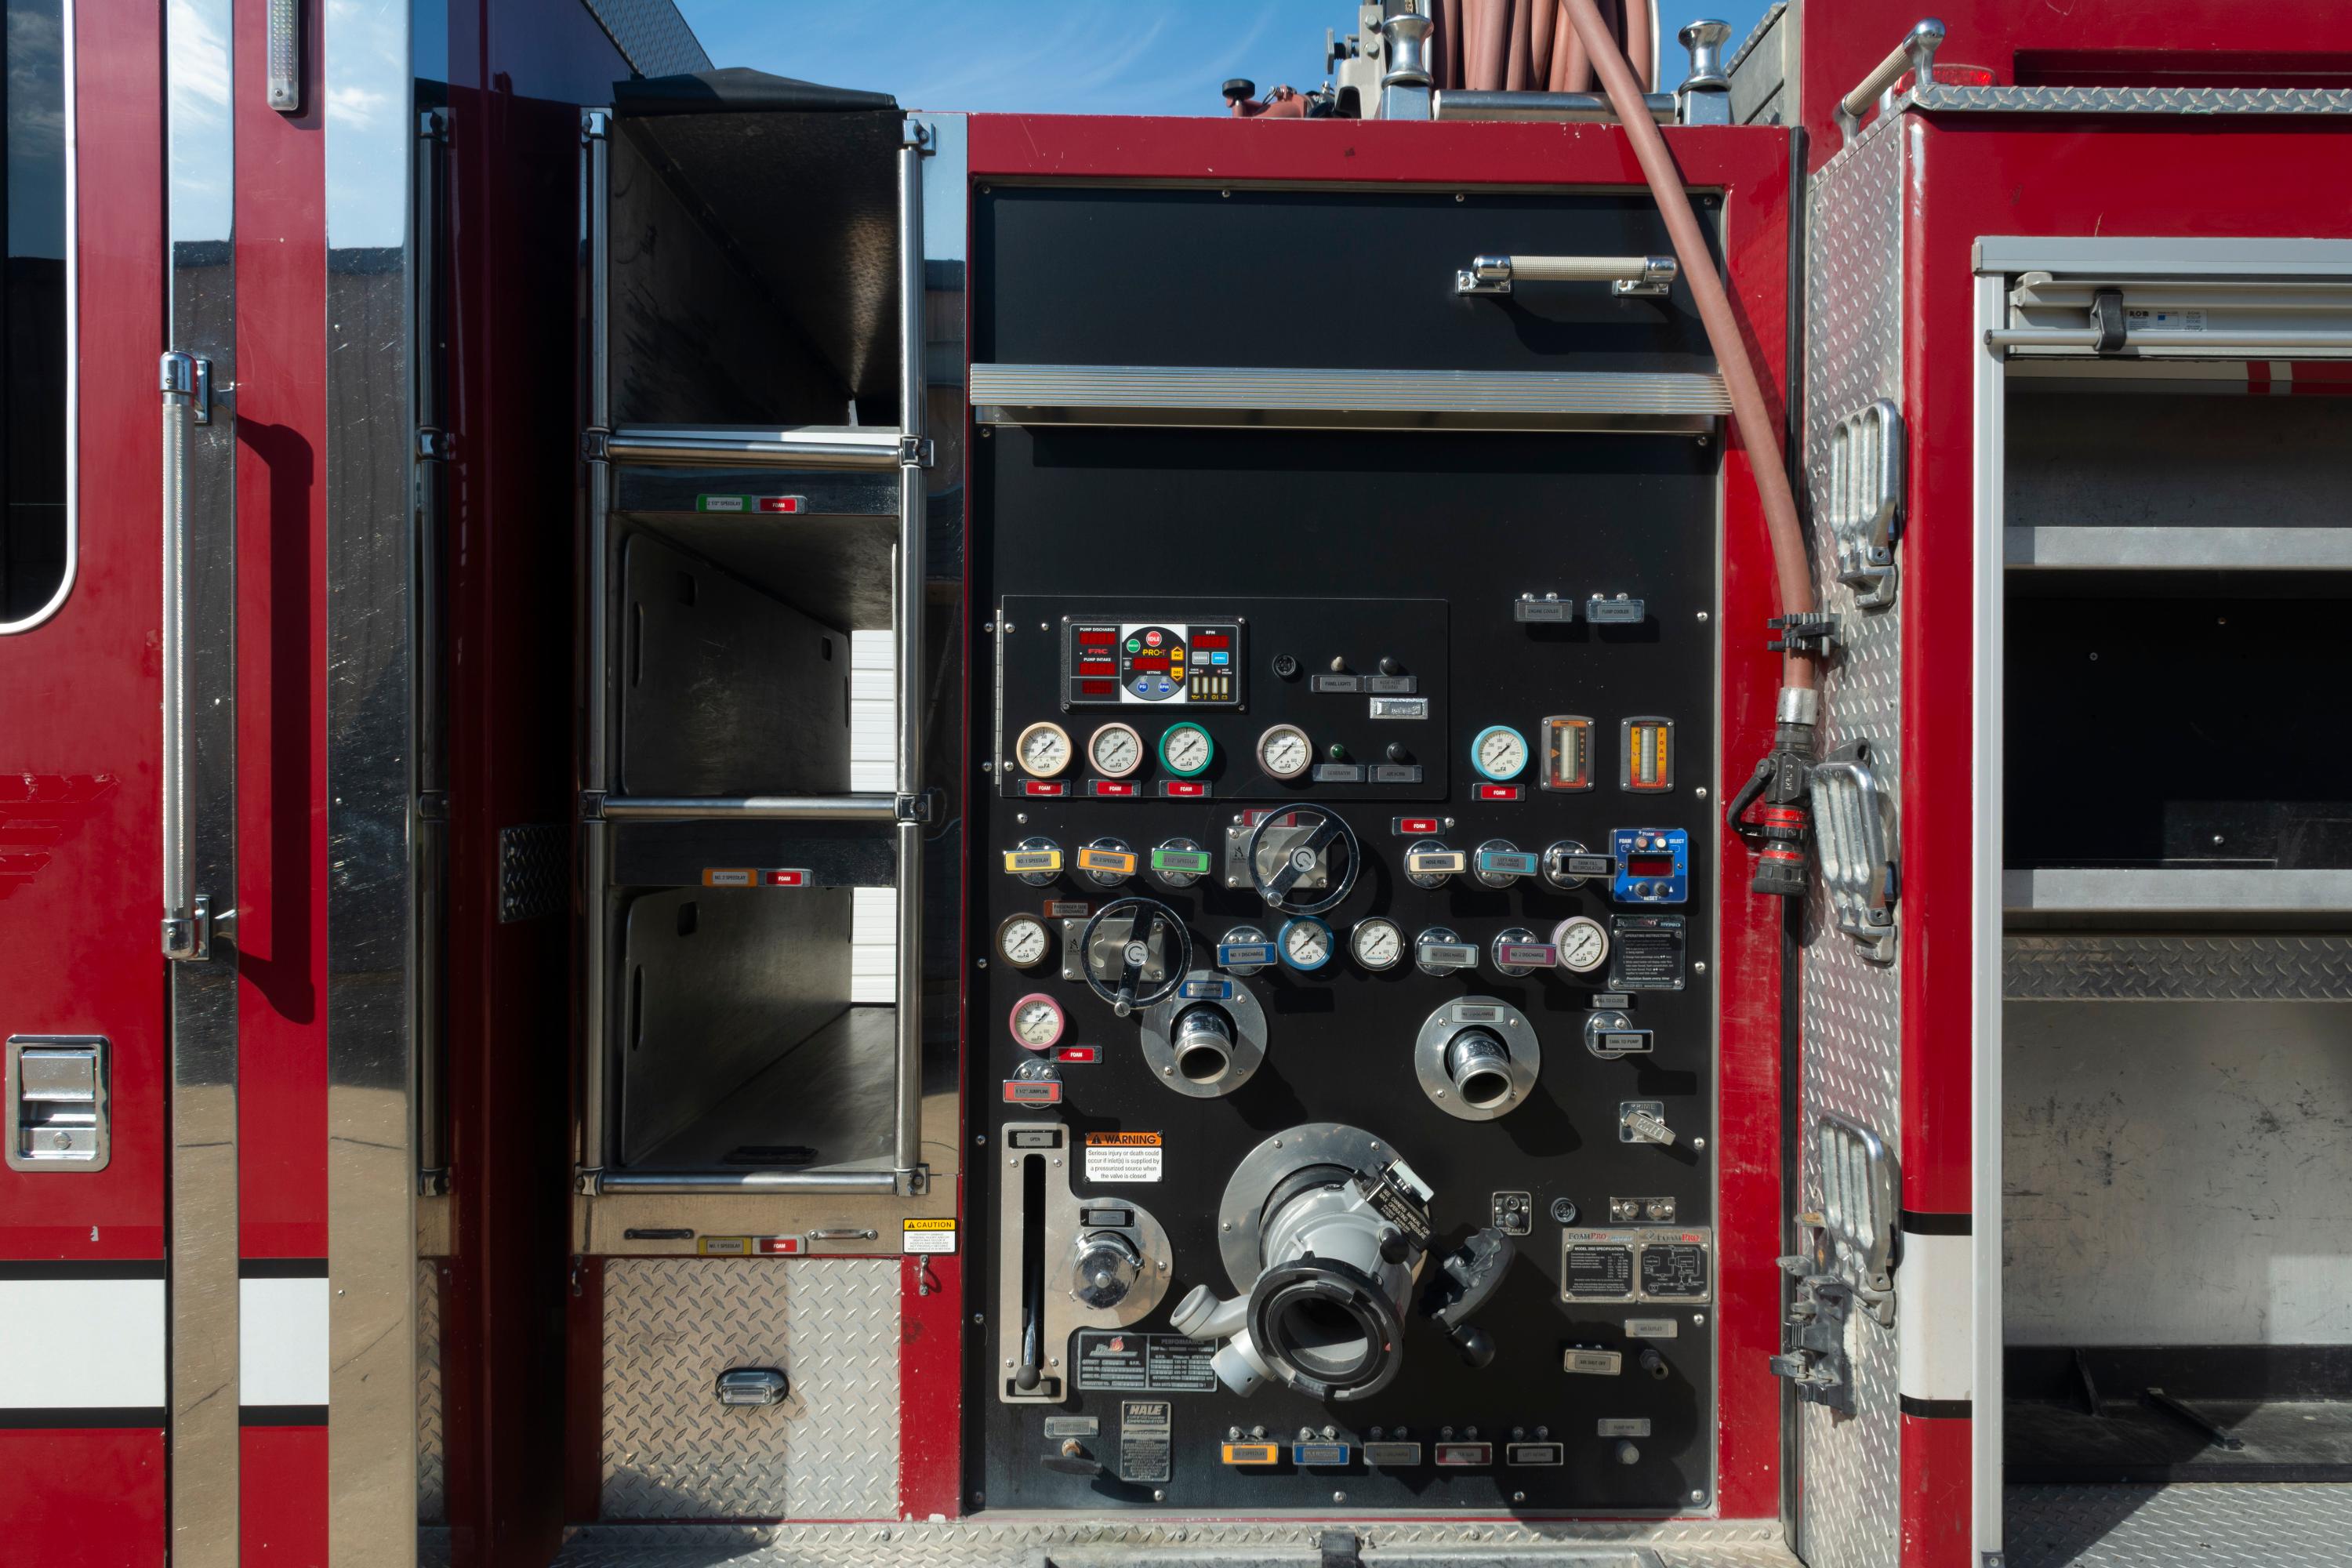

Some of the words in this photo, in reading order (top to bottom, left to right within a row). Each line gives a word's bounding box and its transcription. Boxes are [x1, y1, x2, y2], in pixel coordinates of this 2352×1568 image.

[1105, 1135, 1156, 1144] WARNING
[1378, 1192, 1388, 1202] MAX
[1388, 1201, 1408, 1222] OPERATING
[1407, 1221, 1427, 1240] PRESSURE
[1380, 1207, 1393, 1219] PATENT
[1382, 1189, 1392, 1197] SEE
[1391, 1196, 1407, 1213] OWNERS
[1406, 1211, 1421, 1227] MANUAL
[1421, 1225, 1431, 1236] FOR
[1383, 1204, 1396, 1216] PATENT
[1129, 1404, 1163, 1415] HALE
